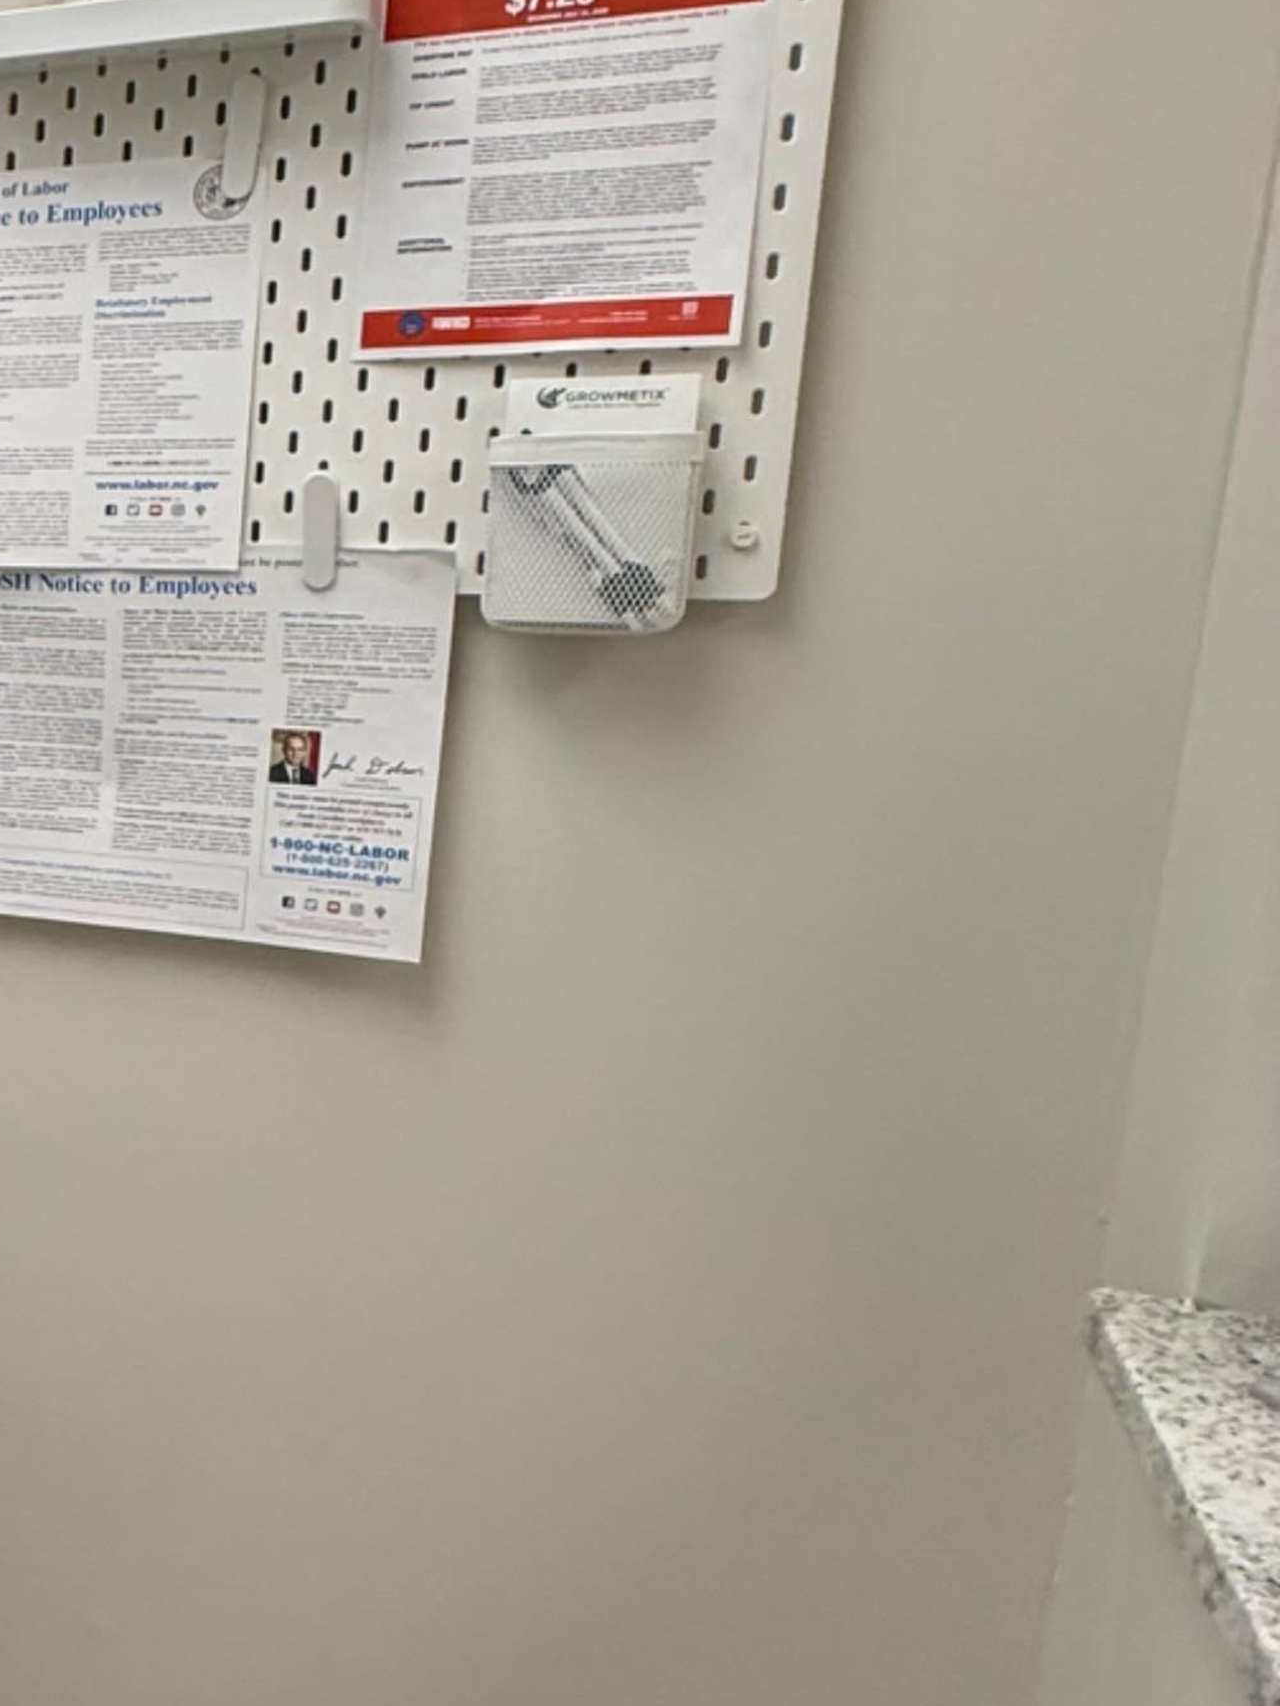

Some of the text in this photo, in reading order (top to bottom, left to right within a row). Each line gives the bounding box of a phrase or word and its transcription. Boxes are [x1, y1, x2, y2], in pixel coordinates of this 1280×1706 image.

[2, 182, 19, 198] of
[22, 181, 69, 197] Labor
[19, 207, 40, 225] to
[47, 199, 163, 226] Employees
[39, 573, 104, 594] Notice
[110, 575, 131, 594] to
[140, 575, 258, 600] Employees
